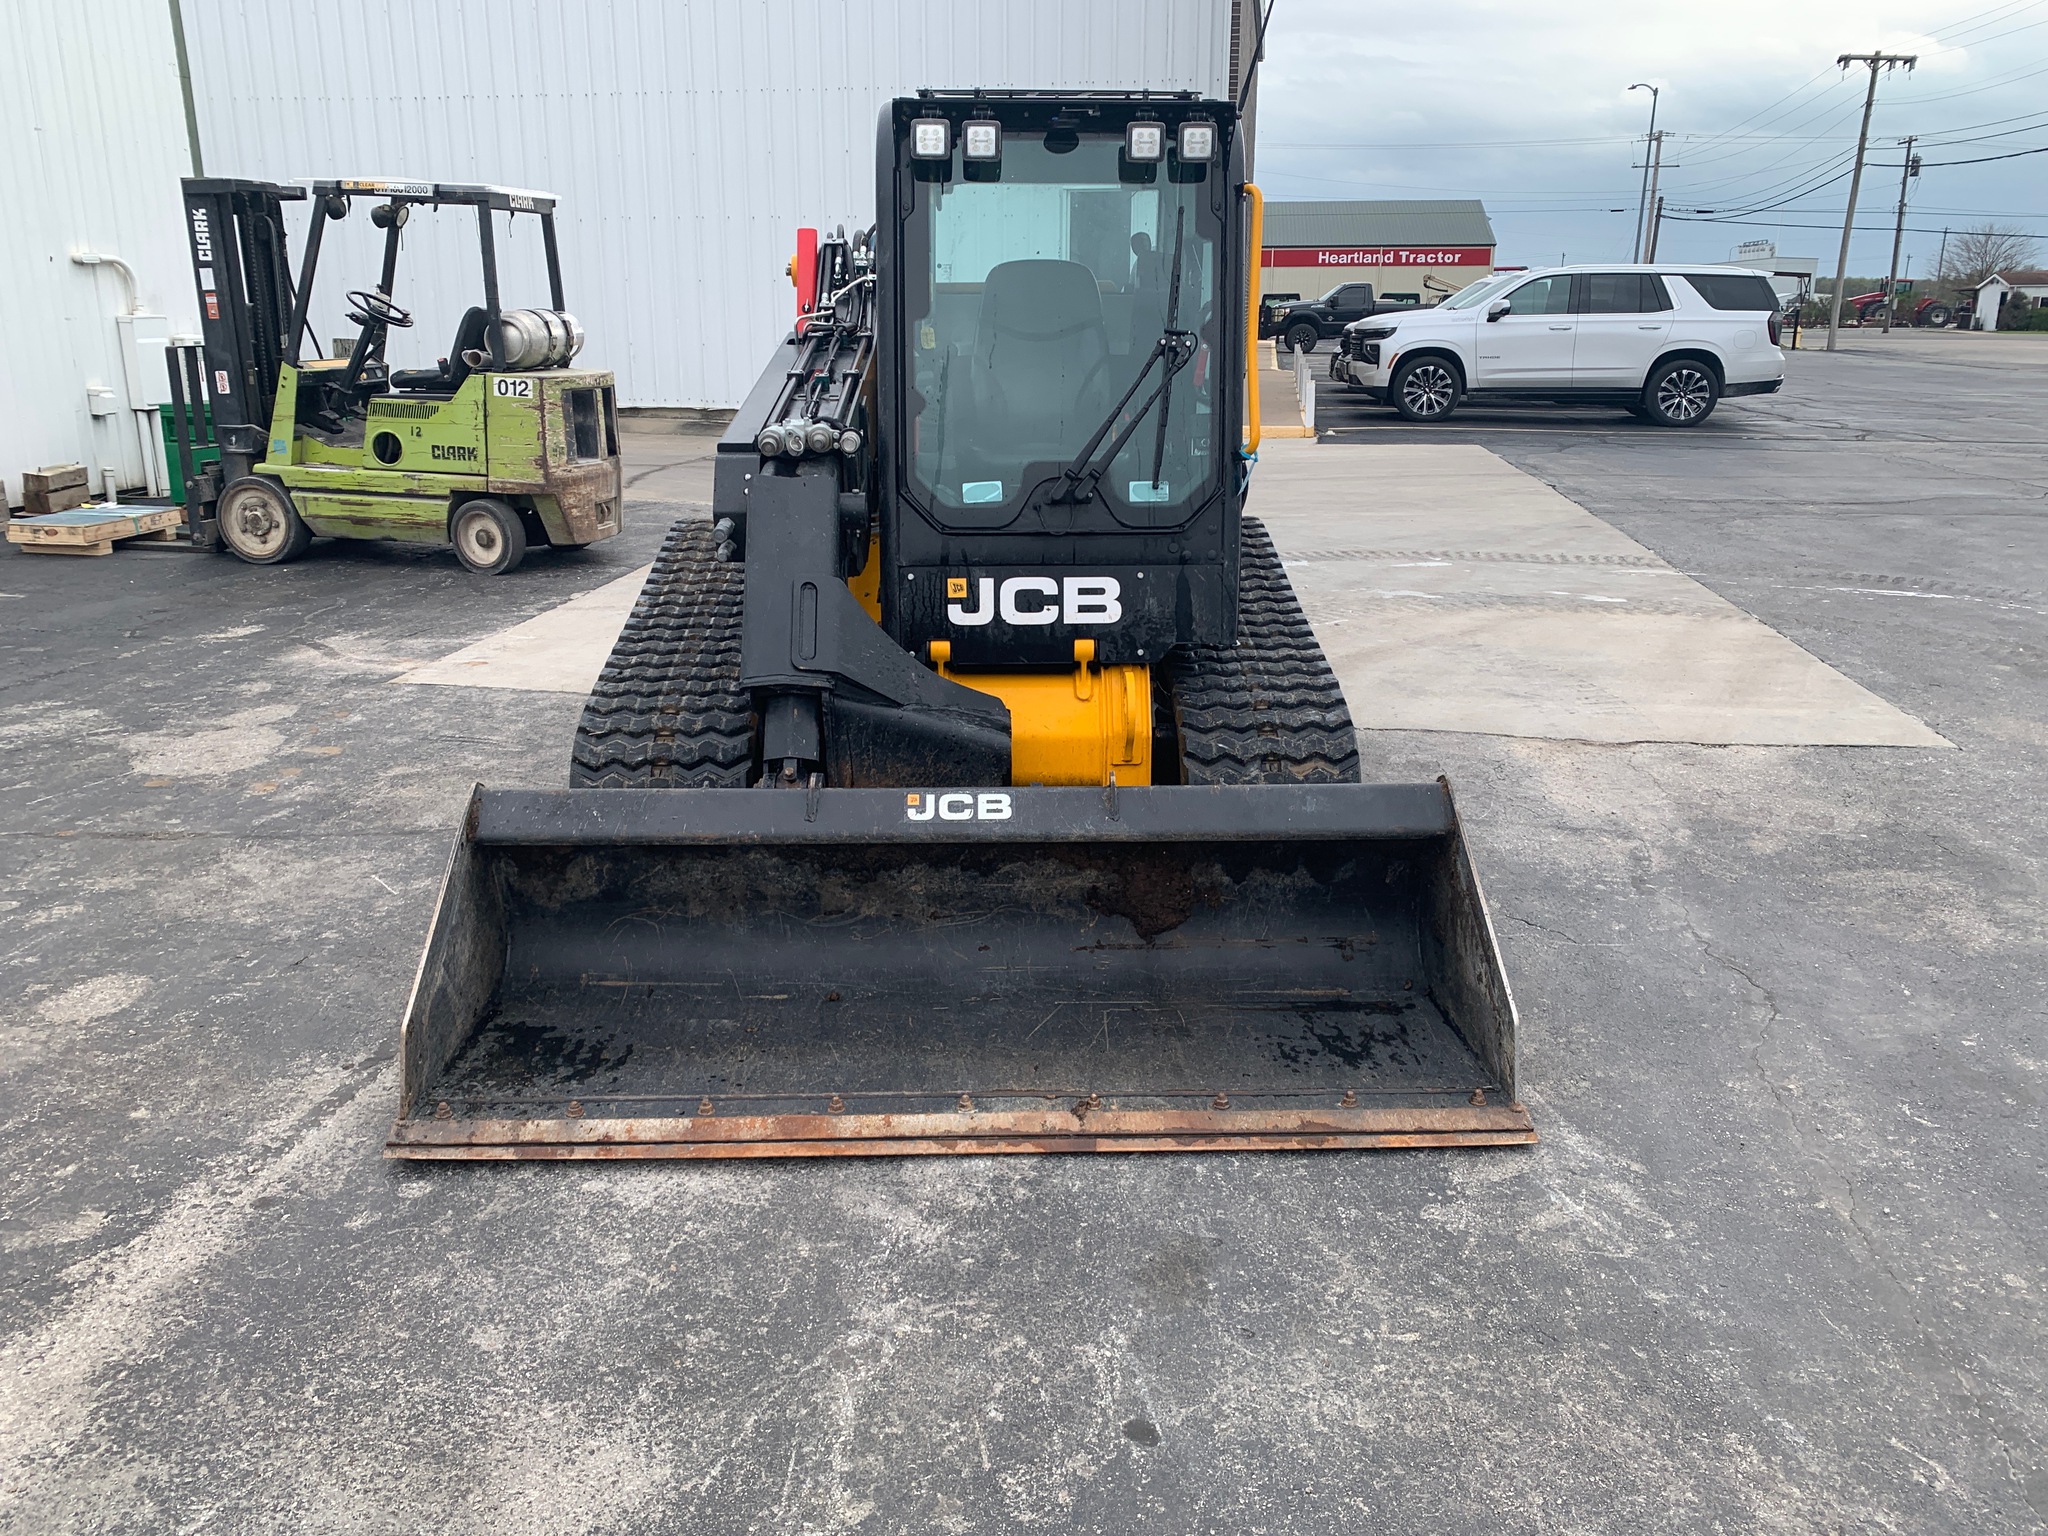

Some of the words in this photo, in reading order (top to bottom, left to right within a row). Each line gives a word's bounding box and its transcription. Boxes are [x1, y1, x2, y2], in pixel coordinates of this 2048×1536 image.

[508, 194, 535, 210] CLARK
[193, 208, 213, 261] CLARK
[1318, 251, 1394, 264] Heartland
[1399, 251, 1461, 263] Tractor
[497, 379, 529, 397] 012
[410, 426, 422, 438] 12
[431, 445, 478, 461] CLARK
[947, 576, 1122, 626] JCB
[907, 793, 1012, 821] JCB
